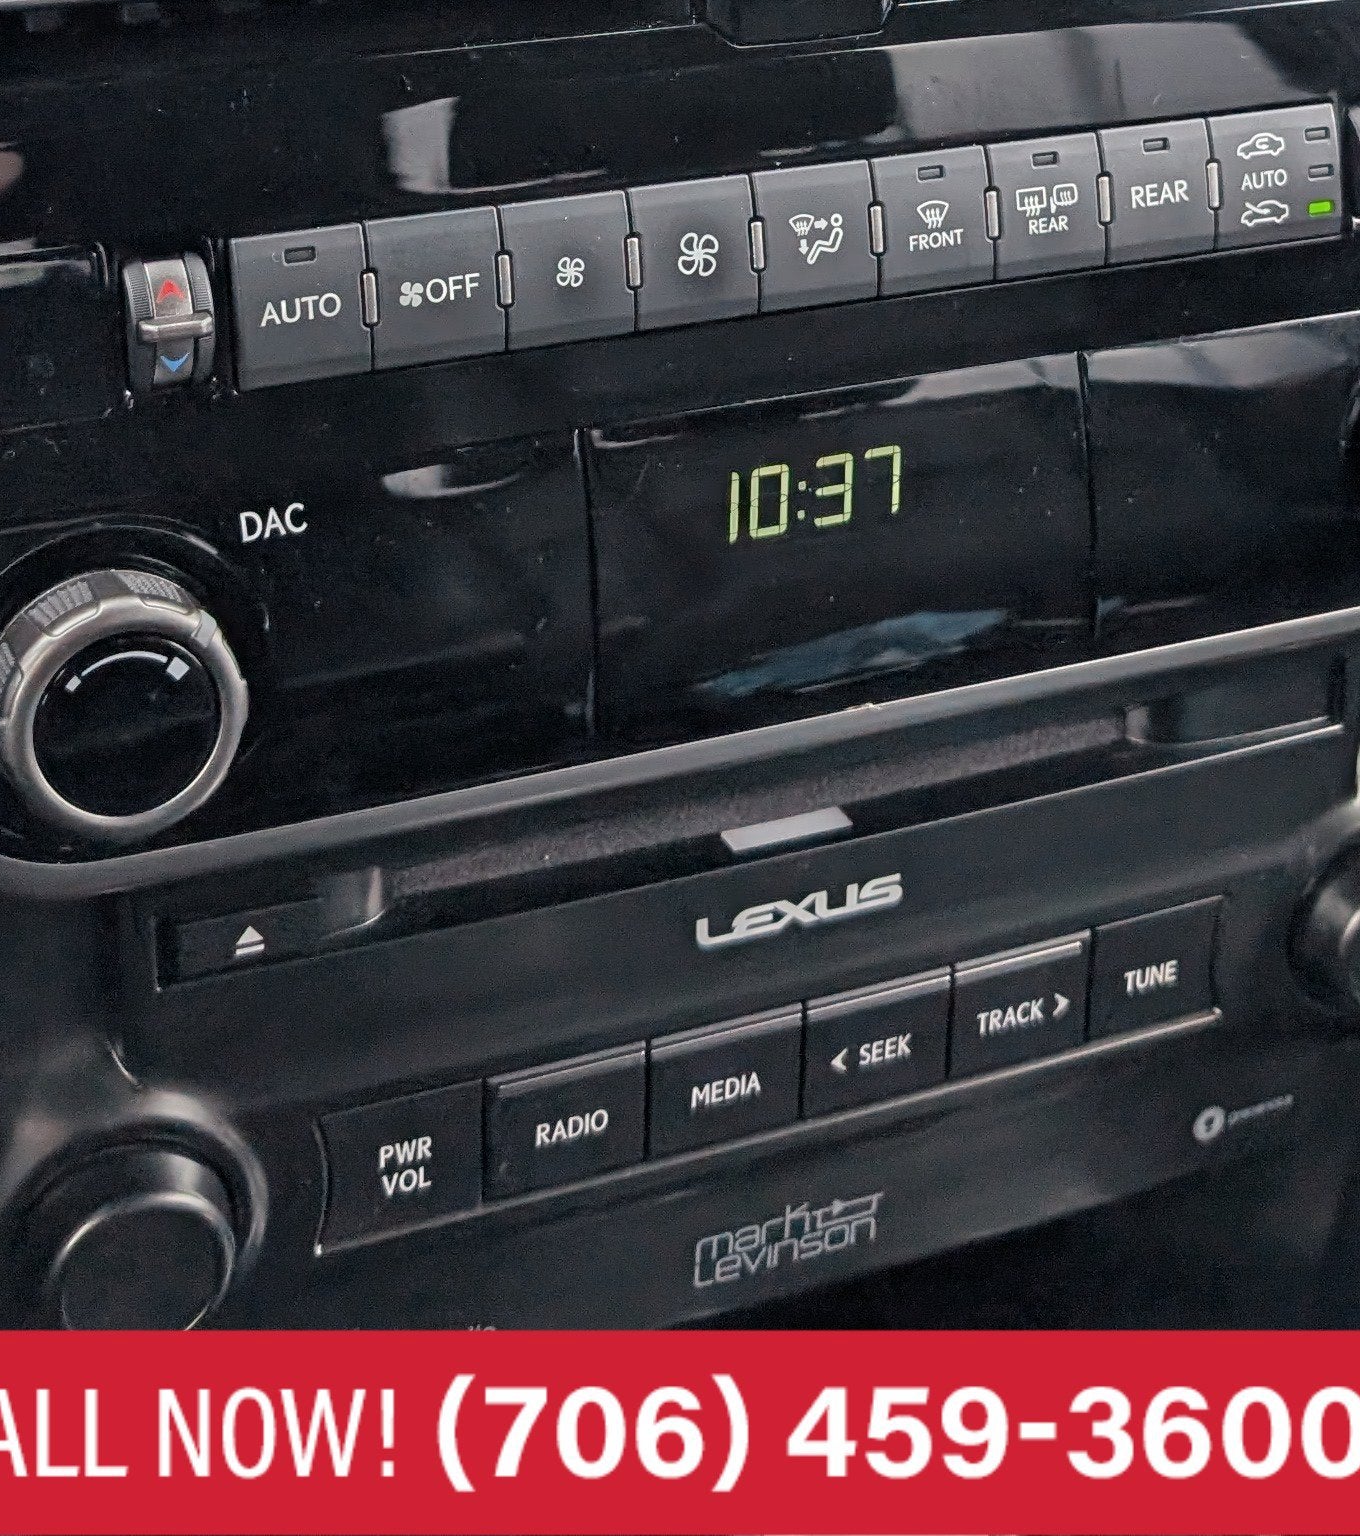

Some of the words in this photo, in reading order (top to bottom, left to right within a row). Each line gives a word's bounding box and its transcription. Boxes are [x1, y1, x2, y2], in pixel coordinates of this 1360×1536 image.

[1130, 180, 1189, 208] REAR
[1241, 169, 1287, 190] AUTO
[909, 228, 964, 252] FRONT
[1028, 215, 1069, 235] REAR
[426, 273, 480, 305] OFF
[260, 293, 342, 329] AUTO
[728, 444, 901, 543] 10:37
[240, 502, 308, 544] DAC
[696, 872, 903, 949] LEXUS
[1124, 960, 1178, 994] TUNE
[977, 1001, 1043, 1036] TRACK
[858, 1033, 912, 1066] SEEK
[691, 1072, 761, 1109] MEDIA
[535, 1109, 608, 1147] RADIO
[379, 1136, 432, 1169] PWR
[381, 1168, 432, 1196] VOL
